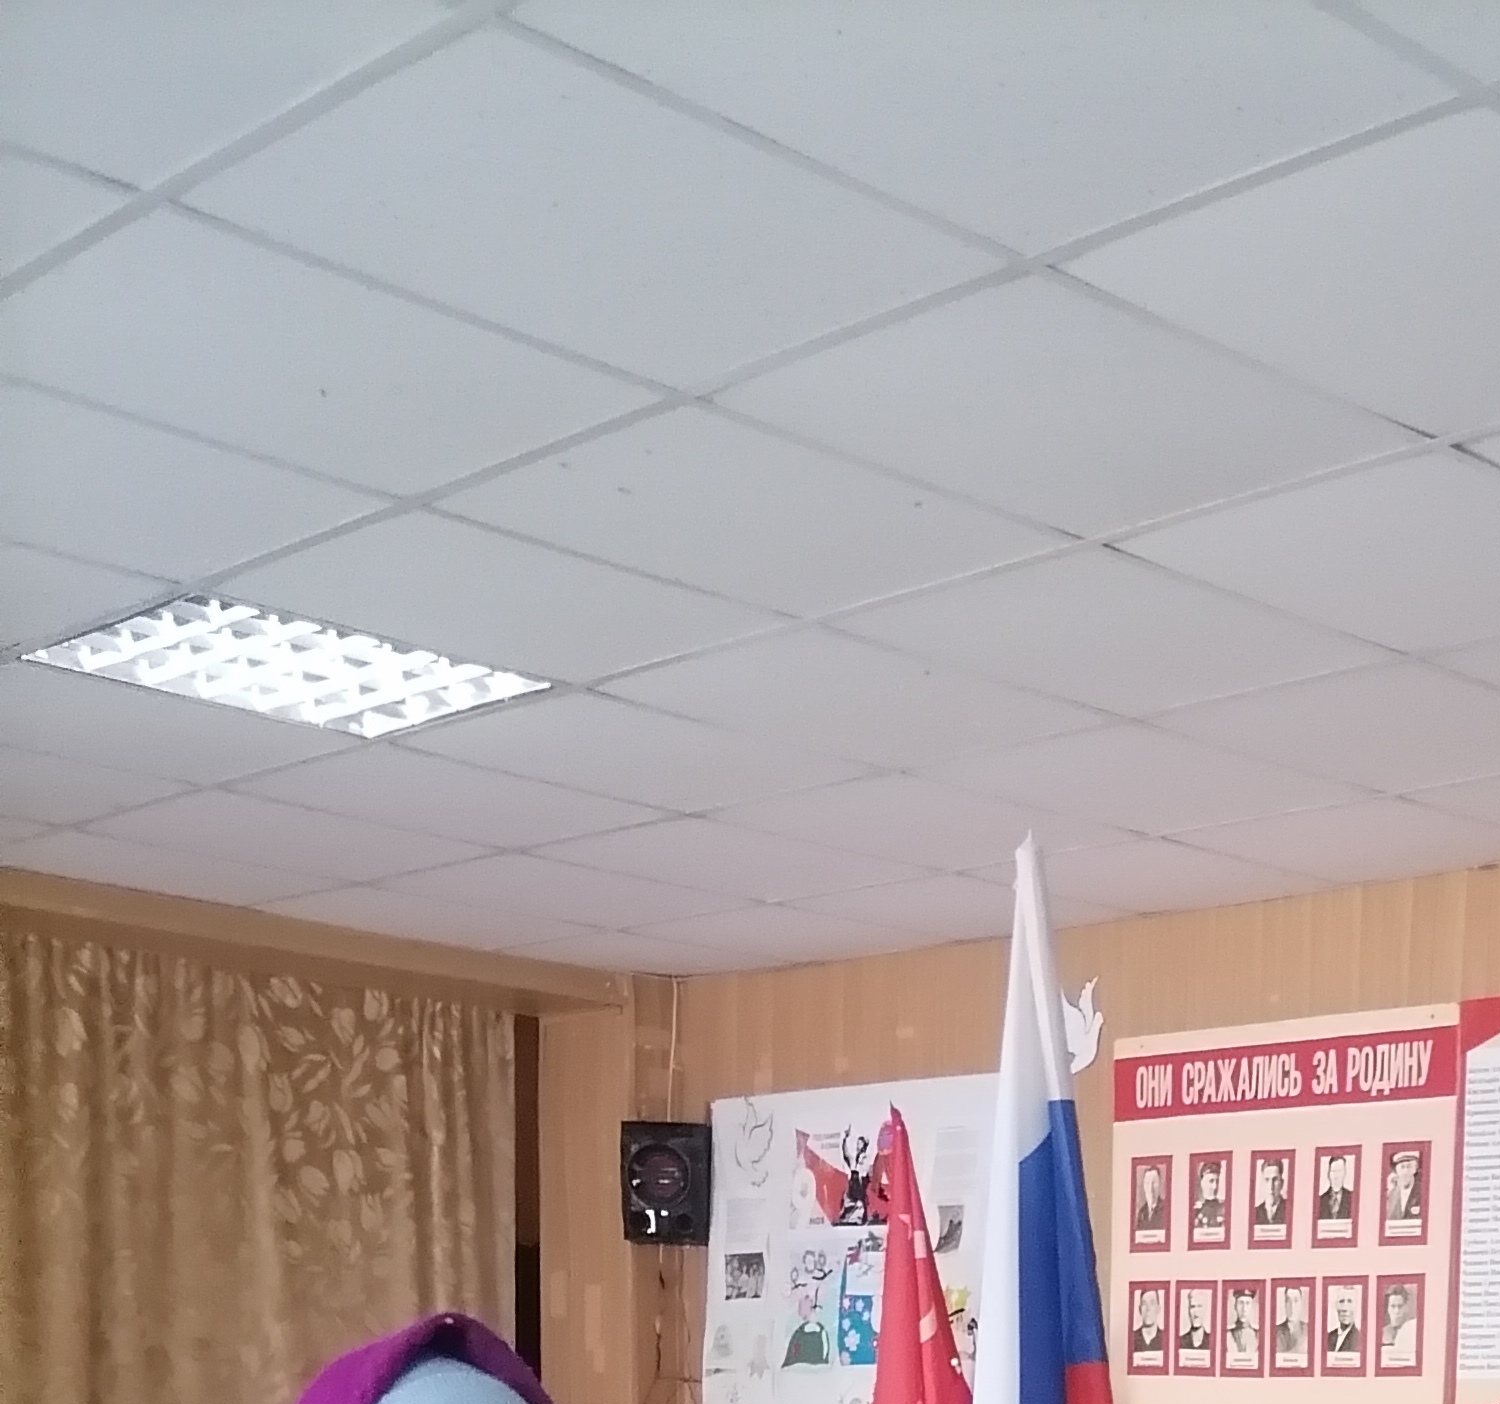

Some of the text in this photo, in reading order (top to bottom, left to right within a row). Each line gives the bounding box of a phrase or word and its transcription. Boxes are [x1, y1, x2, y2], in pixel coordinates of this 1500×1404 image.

[1136, 1040, 1434, 1109] ОНИ СРАЖАЛИСЬ ЗА РОДИНУ
